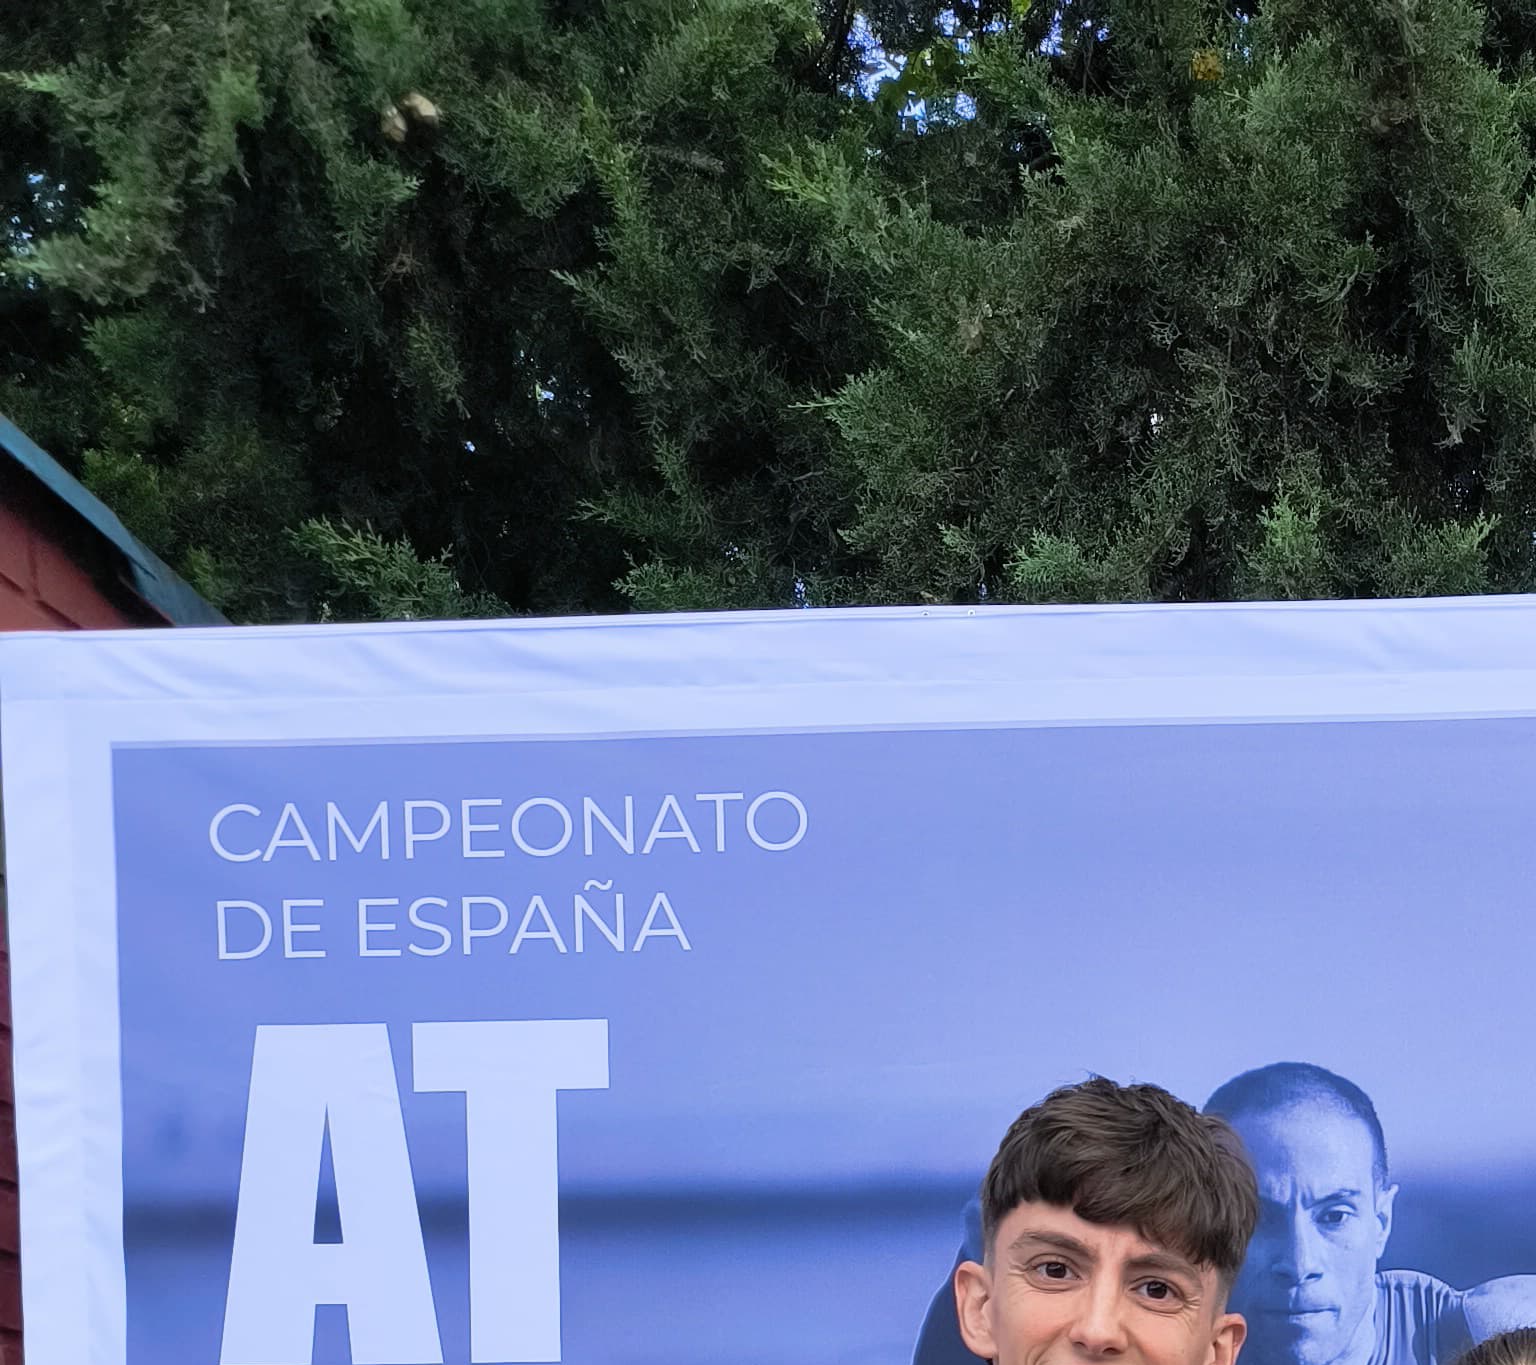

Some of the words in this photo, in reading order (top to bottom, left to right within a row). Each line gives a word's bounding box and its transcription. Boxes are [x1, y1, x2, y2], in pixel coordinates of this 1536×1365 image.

[208, 790, 809, 863] CAMPEONATO
[216, 897, 327, 960] DE
[358, 879, 692, 957] ESPAÑA
[219, 1018, 610, 1365] AT
